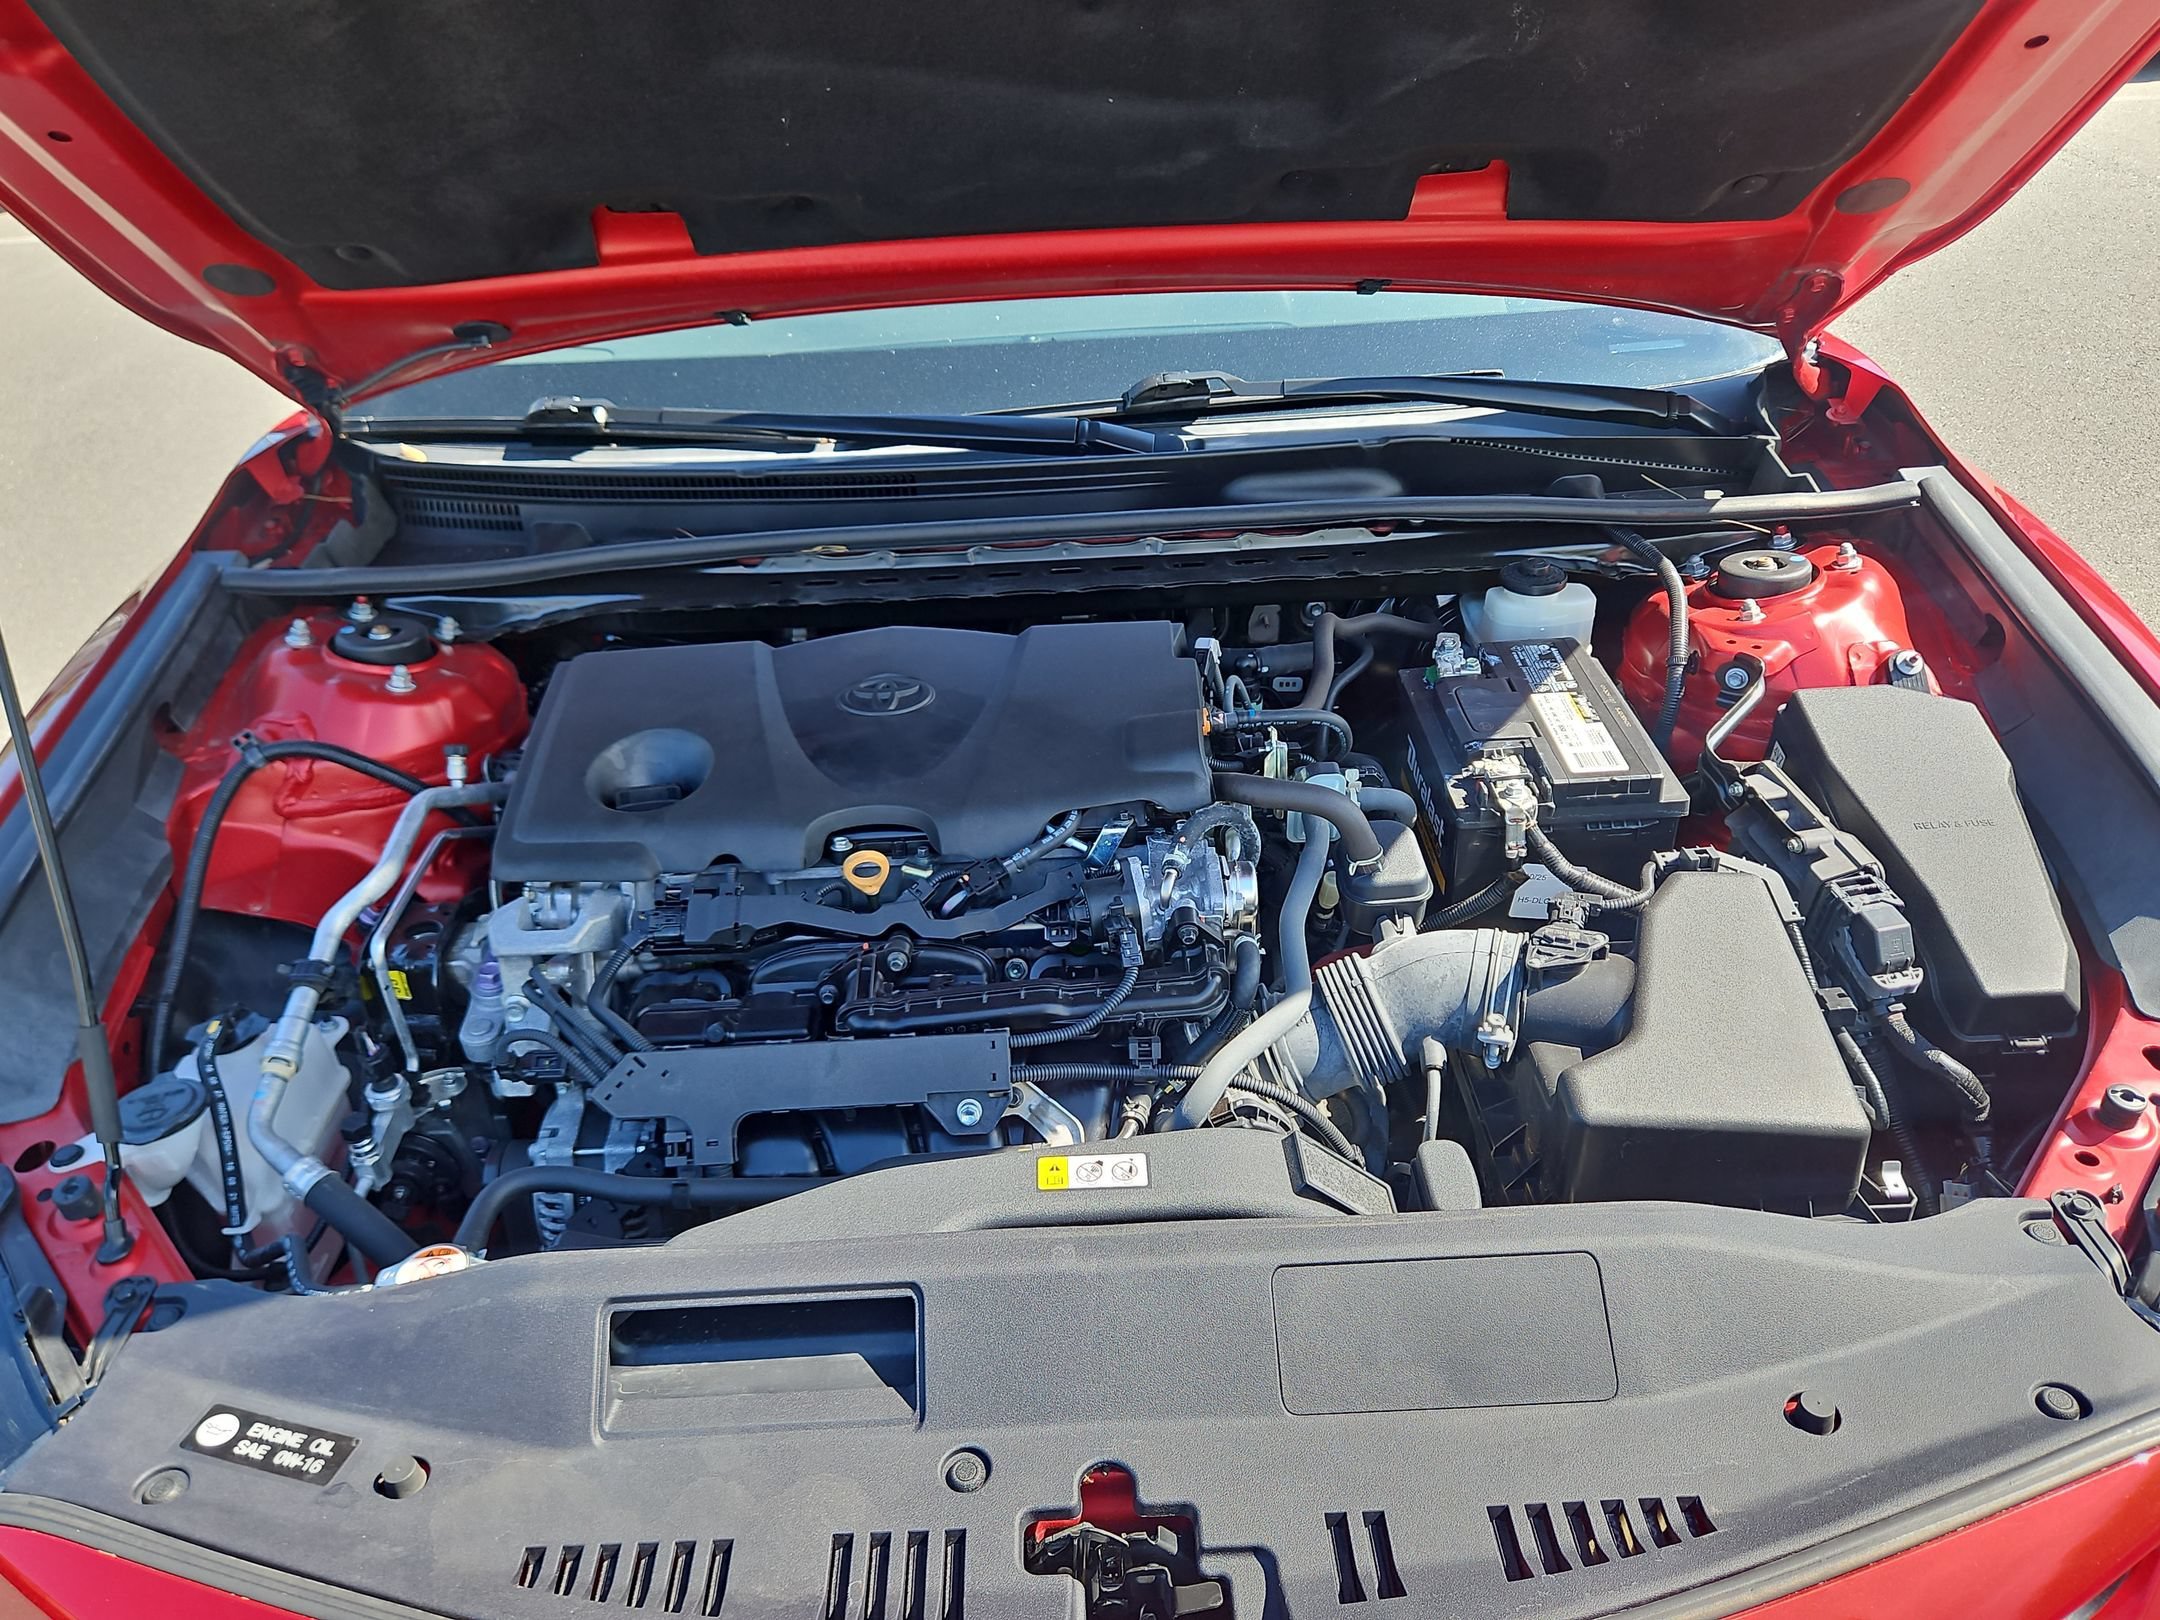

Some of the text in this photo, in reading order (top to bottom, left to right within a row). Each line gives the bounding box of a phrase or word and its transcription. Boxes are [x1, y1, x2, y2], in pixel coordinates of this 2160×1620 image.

[1407, 733, 1445, 848] Duralast
[1912, 820, 1951, 830] RELAY
[1963, 818, 1996, 828] FUSE
[233, 1439, 326, 1474] SAE 0W-16
[246, 1422, 336, 1457] ENGINE OIL
